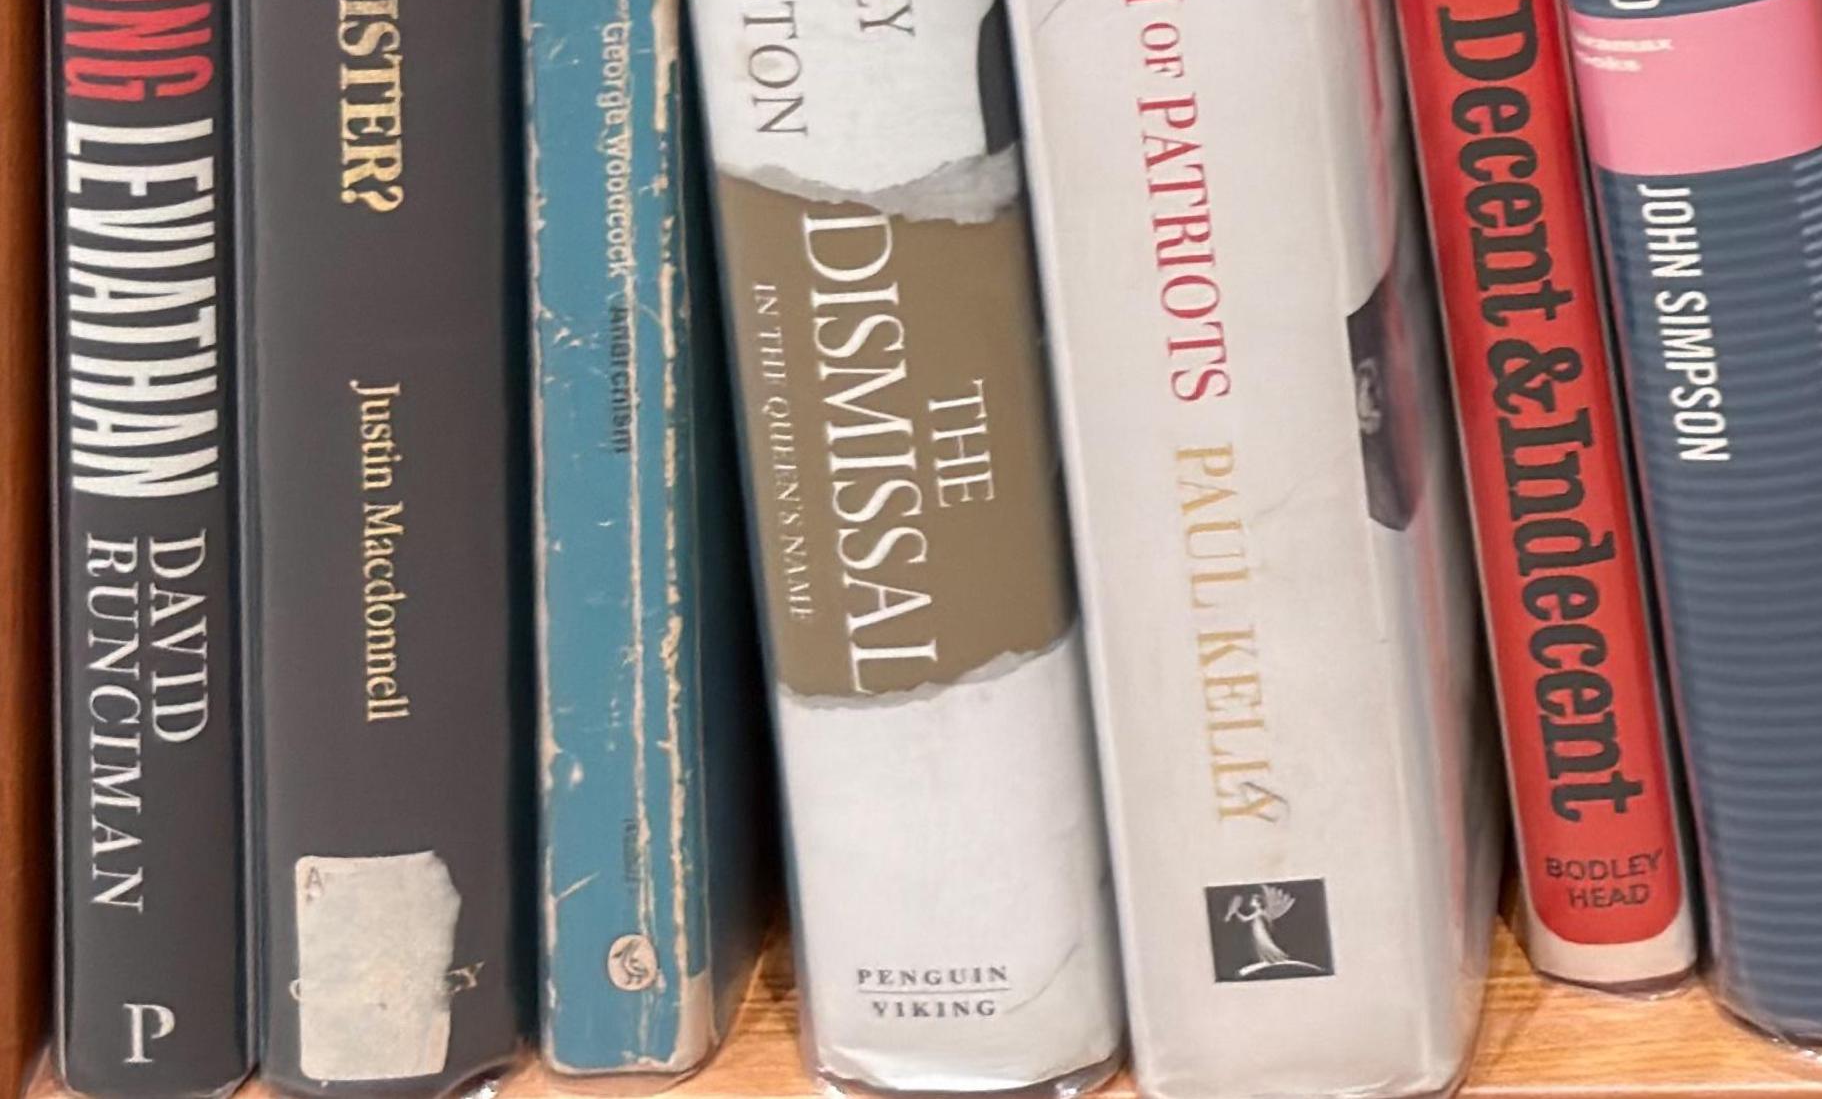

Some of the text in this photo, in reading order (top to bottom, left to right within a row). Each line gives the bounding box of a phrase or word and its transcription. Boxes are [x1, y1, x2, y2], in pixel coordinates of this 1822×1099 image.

[1138, 21, 1186, 80] OF
[64, 117, 220, 498] LEVIATHAN
[753, 283, 780, 315] IN
[1135, 92, 1232, 403] PATRIOTS
[1636, 183, 1732, 462] JOHN SIMPSON
[803, 211, 938, 696] DISMISSAL
[928, 378, 996, 508] THE
[1174, 440, 1251, 612] PAUL
[149, 528, 209, 743] DAVID
[350, 378, 411, 723] Justin Macdonnell
[86, 532, 144, 914] RUNCIMAN
[1195, 628, 1283, 825] KELLY
[1544, 848, 1665, 882] BODLEY
[1566, 882, 1652, 909] HEAD
[121, 1002, 176, 1064] P
[856, 964, 1009, 987] PENGUIN
[872, 999, 998, 1019] VIKING
